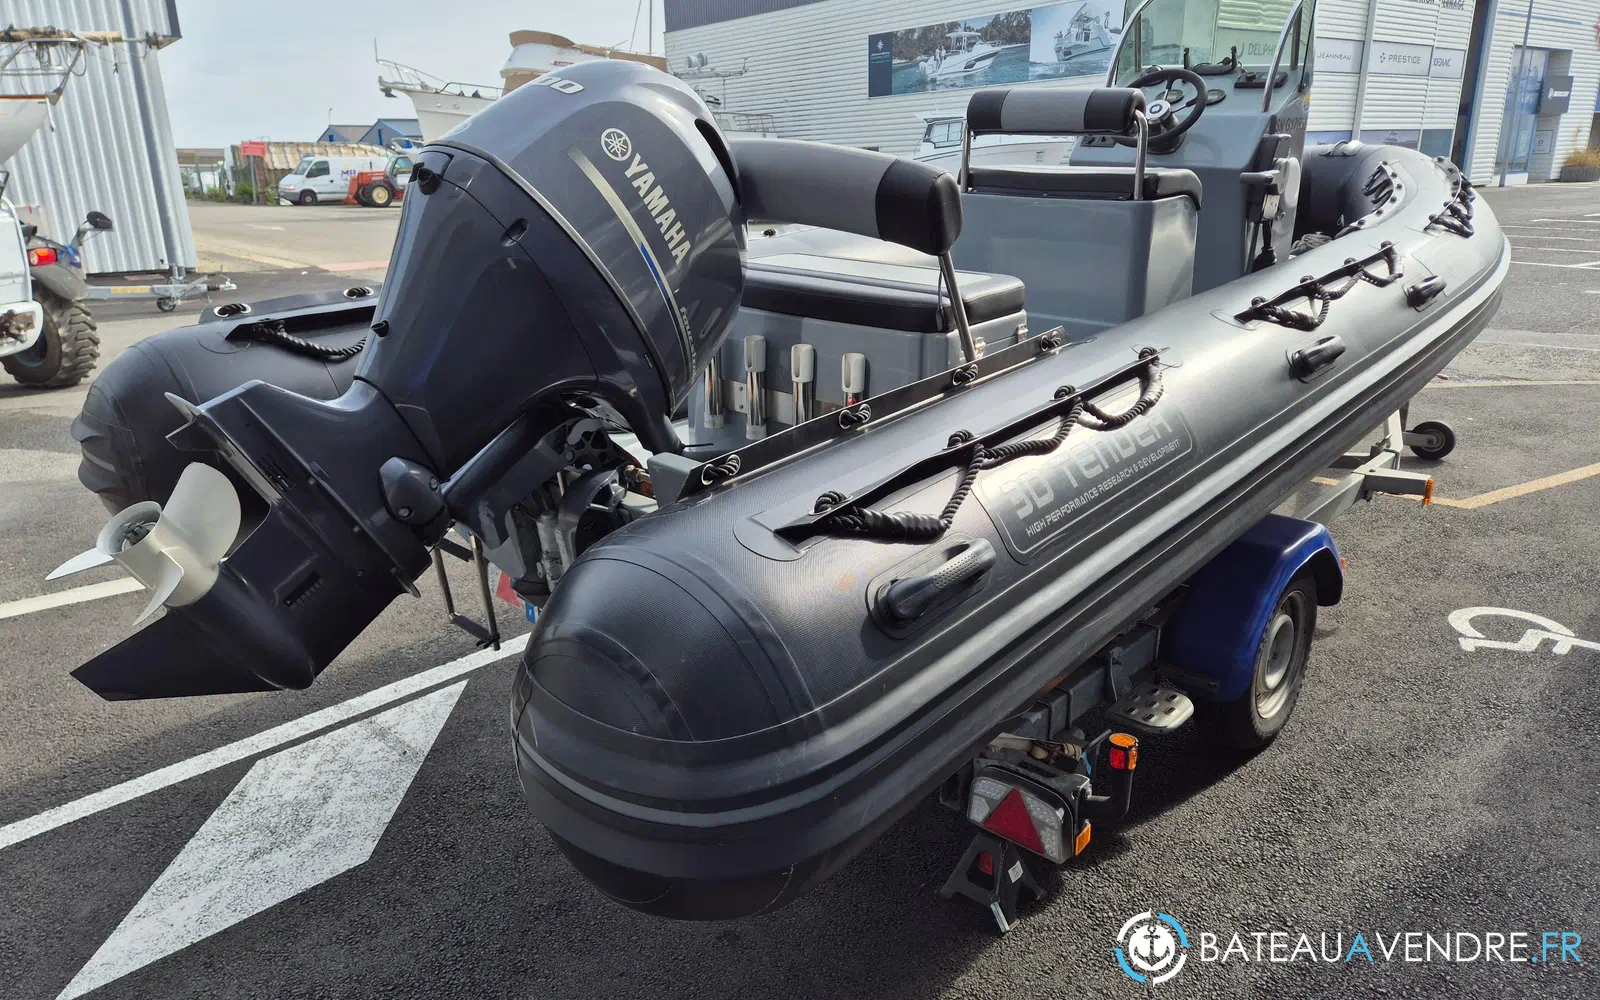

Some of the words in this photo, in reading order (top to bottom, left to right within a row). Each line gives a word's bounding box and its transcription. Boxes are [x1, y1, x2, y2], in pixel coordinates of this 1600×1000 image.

[1317, 52, 1352, 60] JEANNEAU
[1388, 54, 1421, 64] PRESTIGE
[1432, 57, 1451, 67] ODIAC
[624, 153, 692, 266] YAMAHA
[1000, 469, 1055, 520] 3D
[1041, 411, 1173, 489] TENDER
[1025, 518, 1047, 537] HIGH
[1045, 486, 1100, 525] PERFORMANCE
[1097, 466, 1134, 493] RESEARCH
[1138, 438, 1181, 470] DEVELOPMENT
